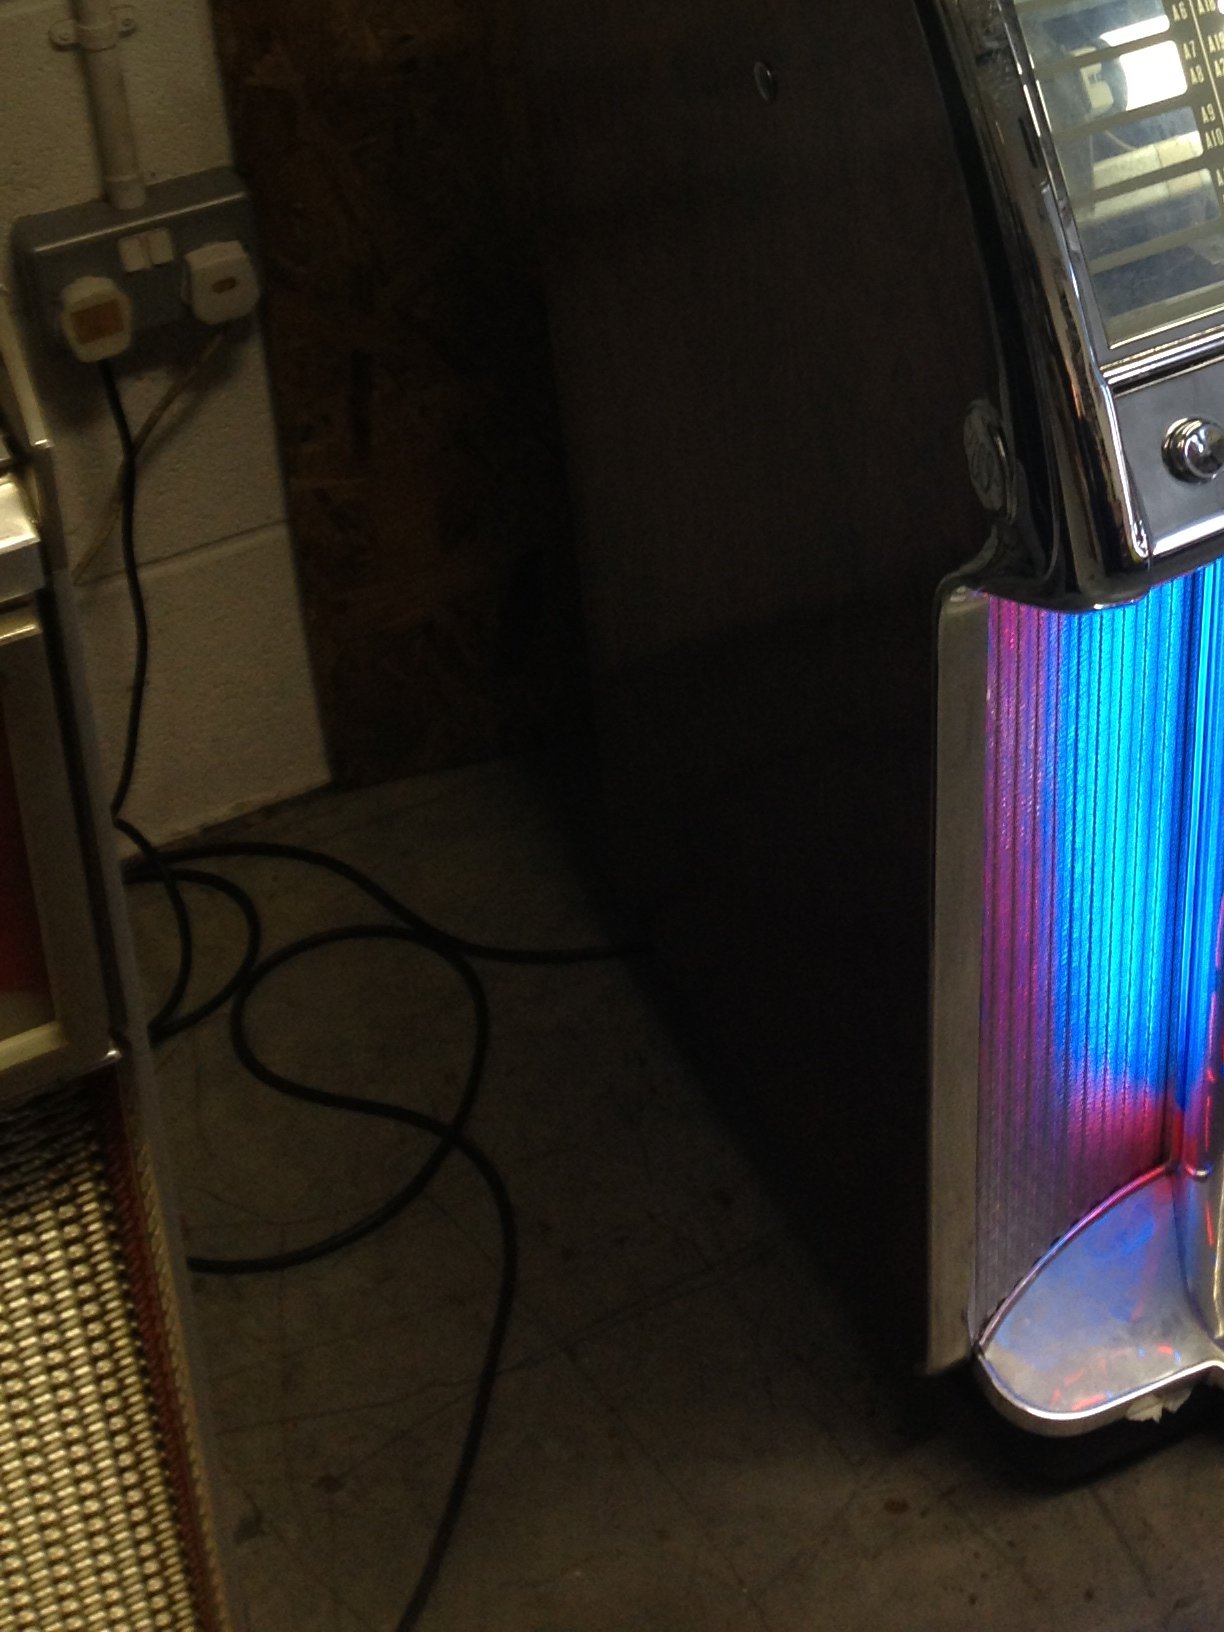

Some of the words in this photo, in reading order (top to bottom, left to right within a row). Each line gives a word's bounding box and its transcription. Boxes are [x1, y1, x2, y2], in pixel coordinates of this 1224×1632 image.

[1172, 1, 1188, 21] A6
[1183, 40, 1196, 60] A7
[1190, 65, 1204, 85] A8
[1201, 104, 1216, 124] A9
[1205, 128, 1224, 149] A10
